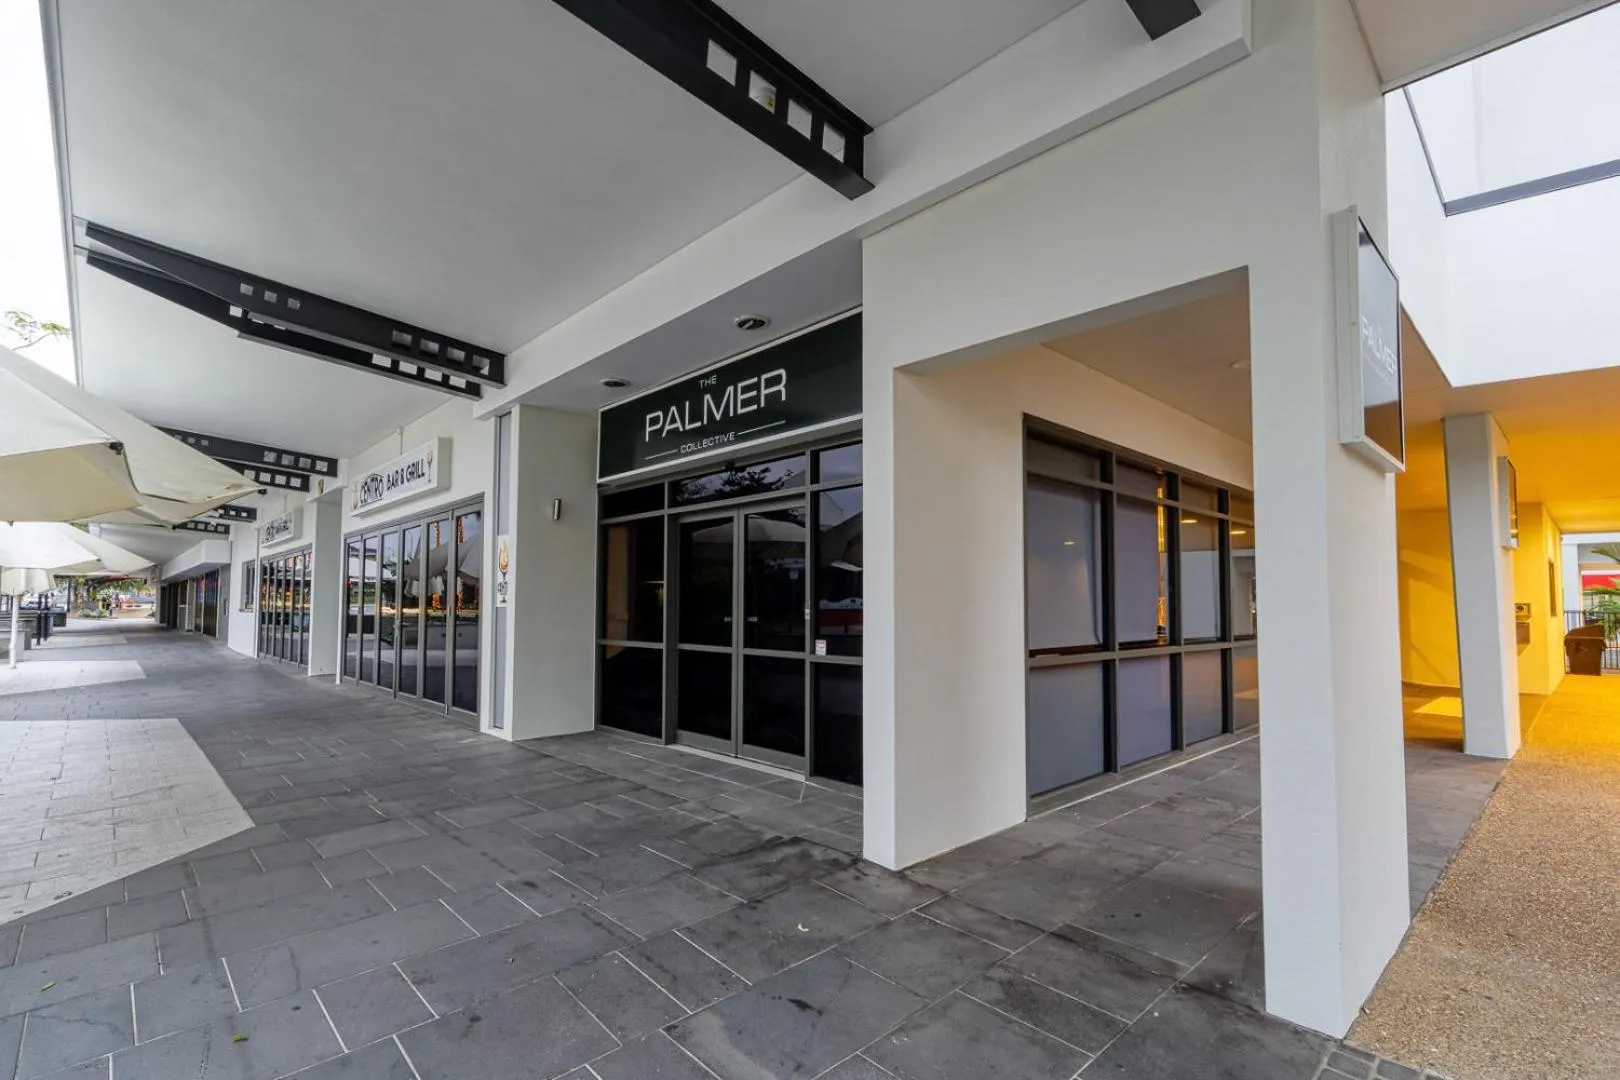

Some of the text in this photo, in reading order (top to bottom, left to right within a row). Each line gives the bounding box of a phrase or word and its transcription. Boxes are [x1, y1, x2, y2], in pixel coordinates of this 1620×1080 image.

[699, 374, 718, 389] THE
[645, 367, 786, 443] PALMER
[680, 431, 736, 454] COLLECTIVE
[386, 469, 399, 491] BAR
[405, 459, 425, 482] GRILL
